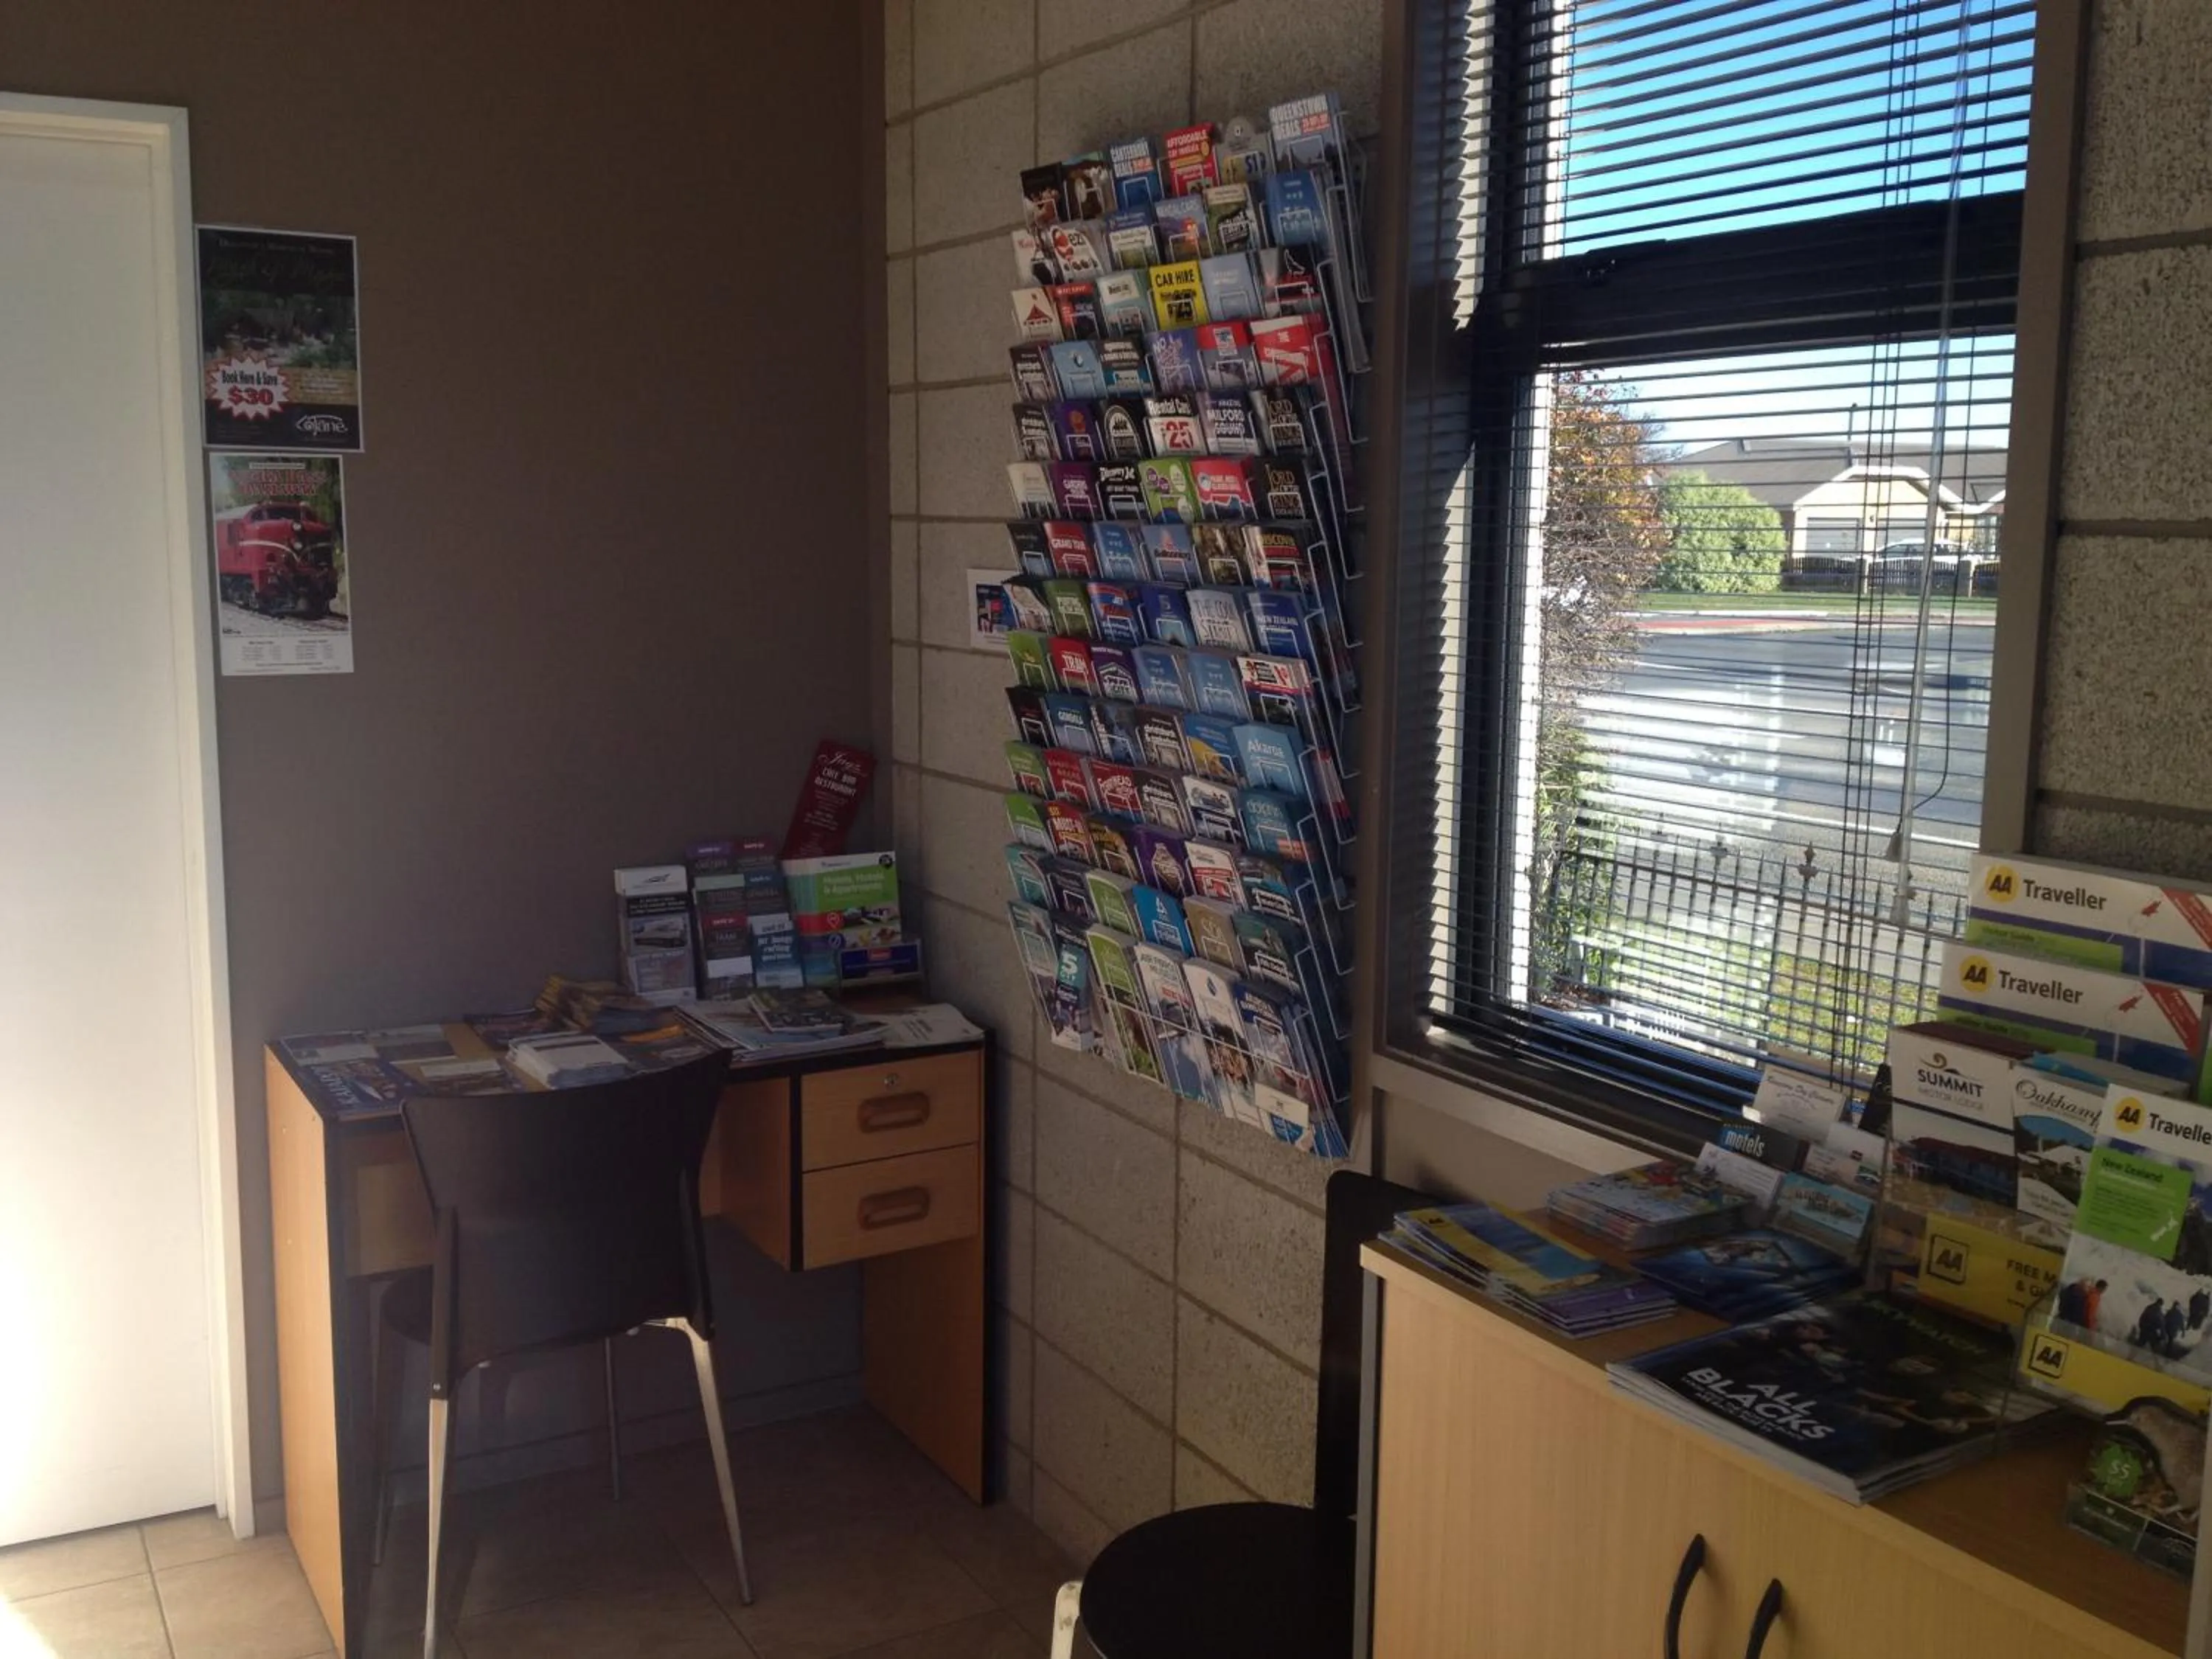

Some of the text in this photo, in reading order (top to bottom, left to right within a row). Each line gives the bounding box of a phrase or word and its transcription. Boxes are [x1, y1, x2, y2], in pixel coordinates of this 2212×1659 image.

[1155, 269, 1195, 287] CAR HIRE
[228, 385, 274, 406] $30
[1989, 874, 2107, 911] AA Traveller
[1963, 963, 2084, 1004] AA Traveller
[1917, 1069, 1984, 1098] SUMMIT
[2117, 1105, 2212, 1145] AA Travelle
[1725, 1130, 1765, 1158] motels
[1935, 1248, 1964, 1273] AA
[2006, 1259, 2040, 1280] FREE
[2036, 1345, 2063, 1369] AA
[1687, 1367, 1836, 1440] BLACKS
[1747, 1383, 1817, 1416] ALL
